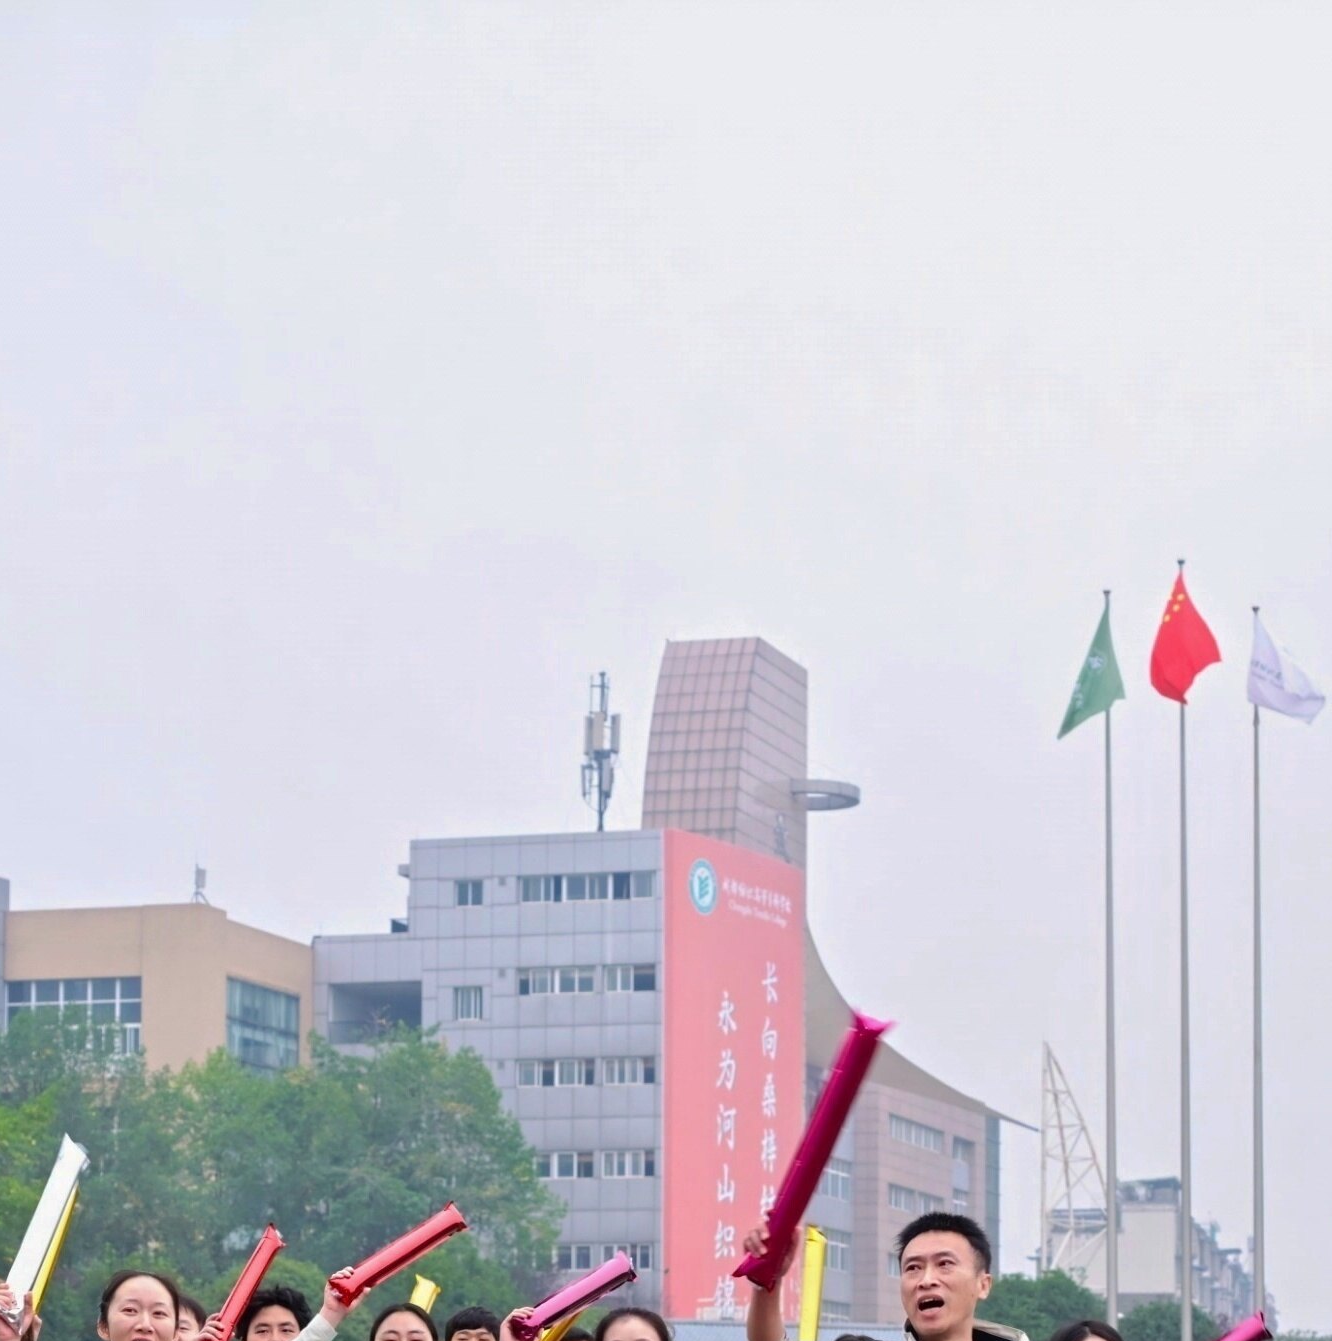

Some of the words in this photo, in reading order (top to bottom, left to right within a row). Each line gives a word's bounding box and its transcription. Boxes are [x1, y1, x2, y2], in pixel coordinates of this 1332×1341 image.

[715, 990, 738, 1320] 永为河山织锦
